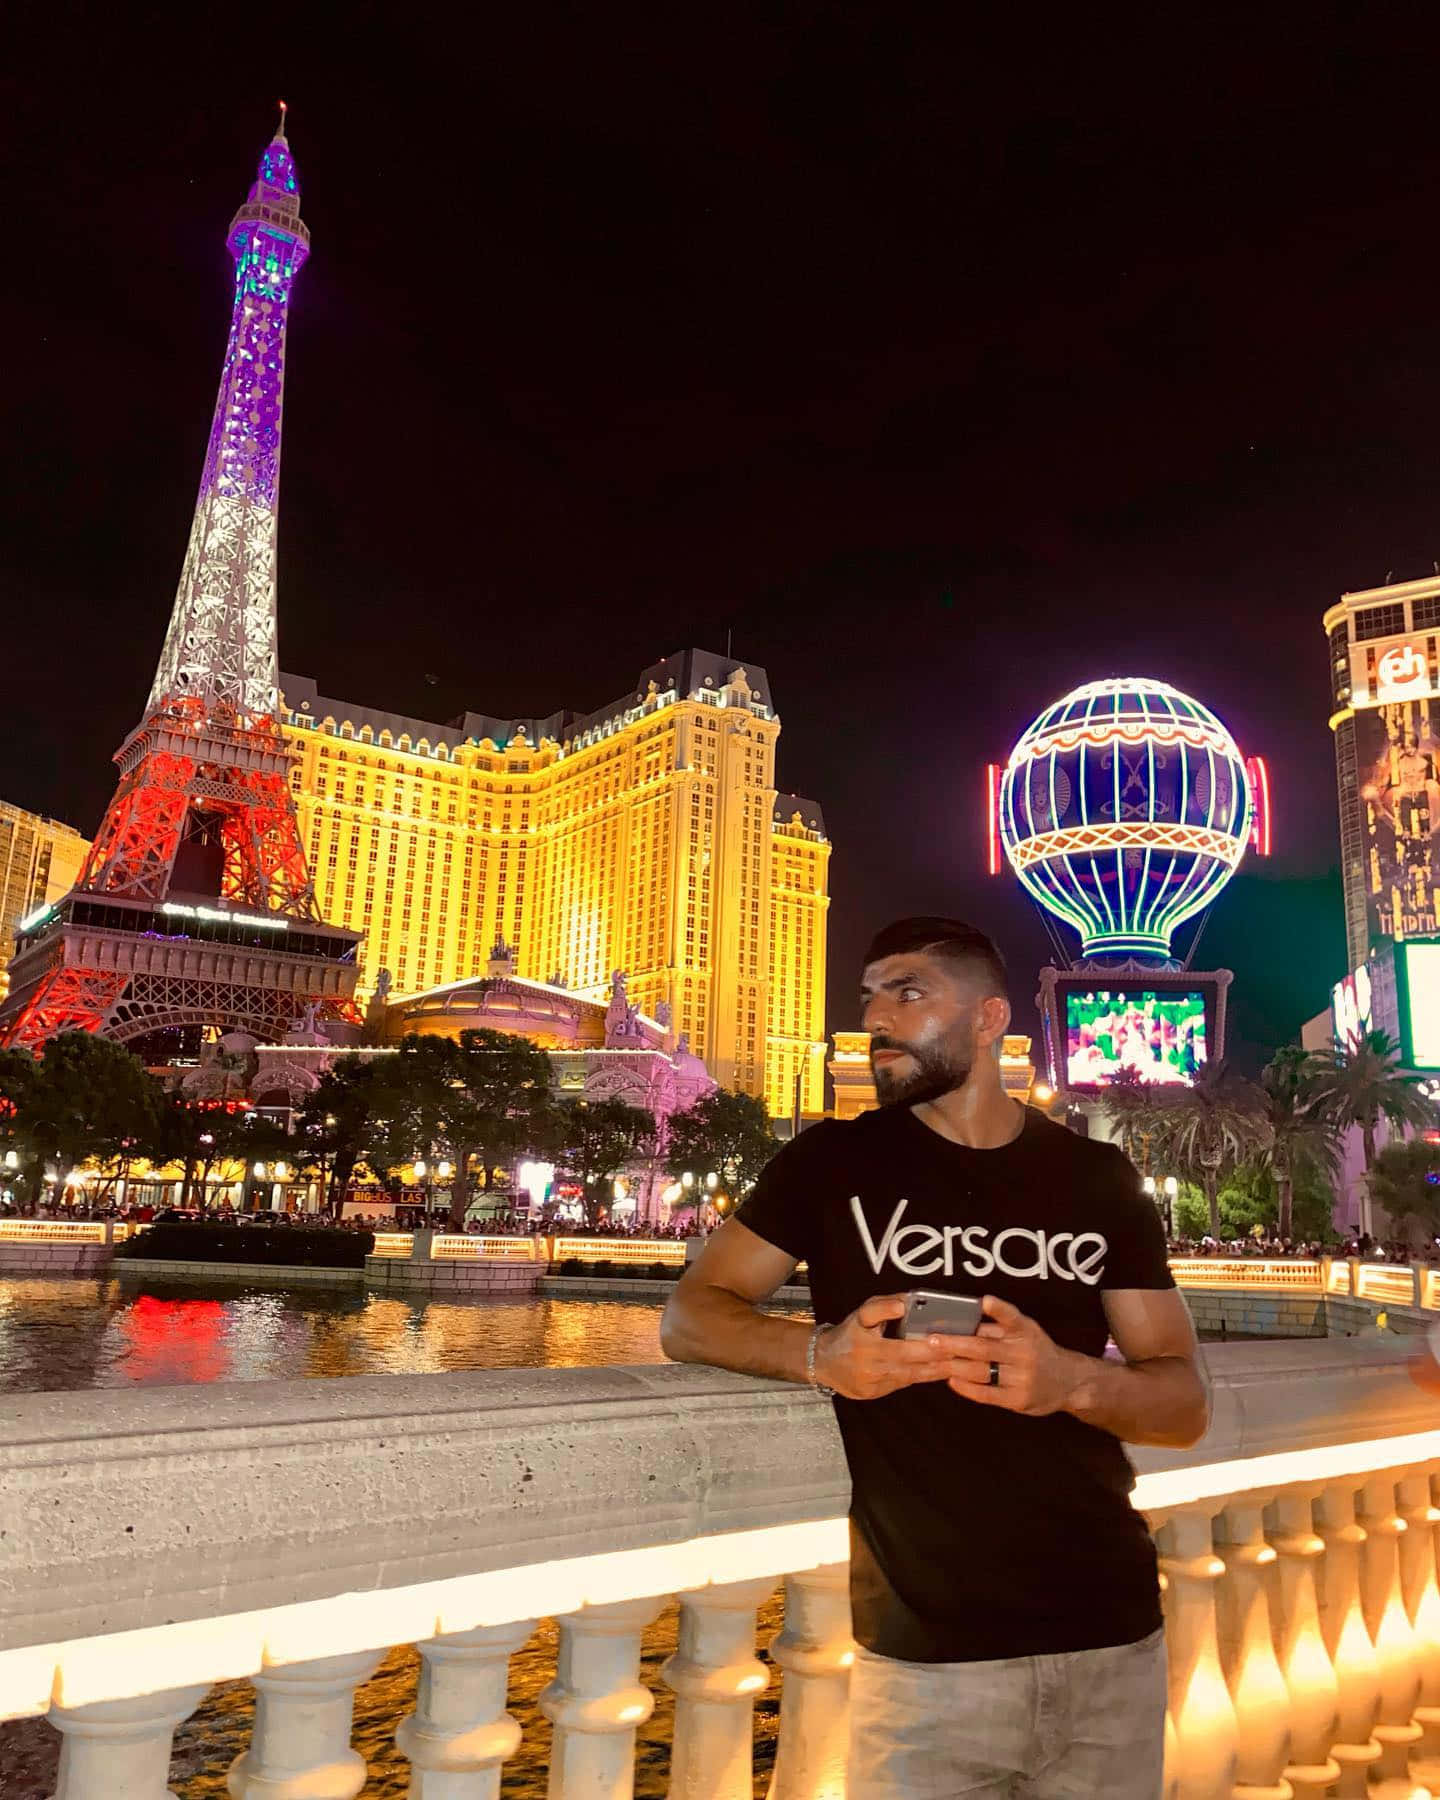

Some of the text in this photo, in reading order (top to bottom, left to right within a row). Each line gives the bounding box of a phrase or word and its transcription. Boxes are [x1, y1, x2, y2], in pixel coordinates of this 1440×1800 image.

[353, 1191, 371, 1202] BIG
[400, 1193, 422, 1203] LAS
[850, 1196, 1108, 1285] Versace
